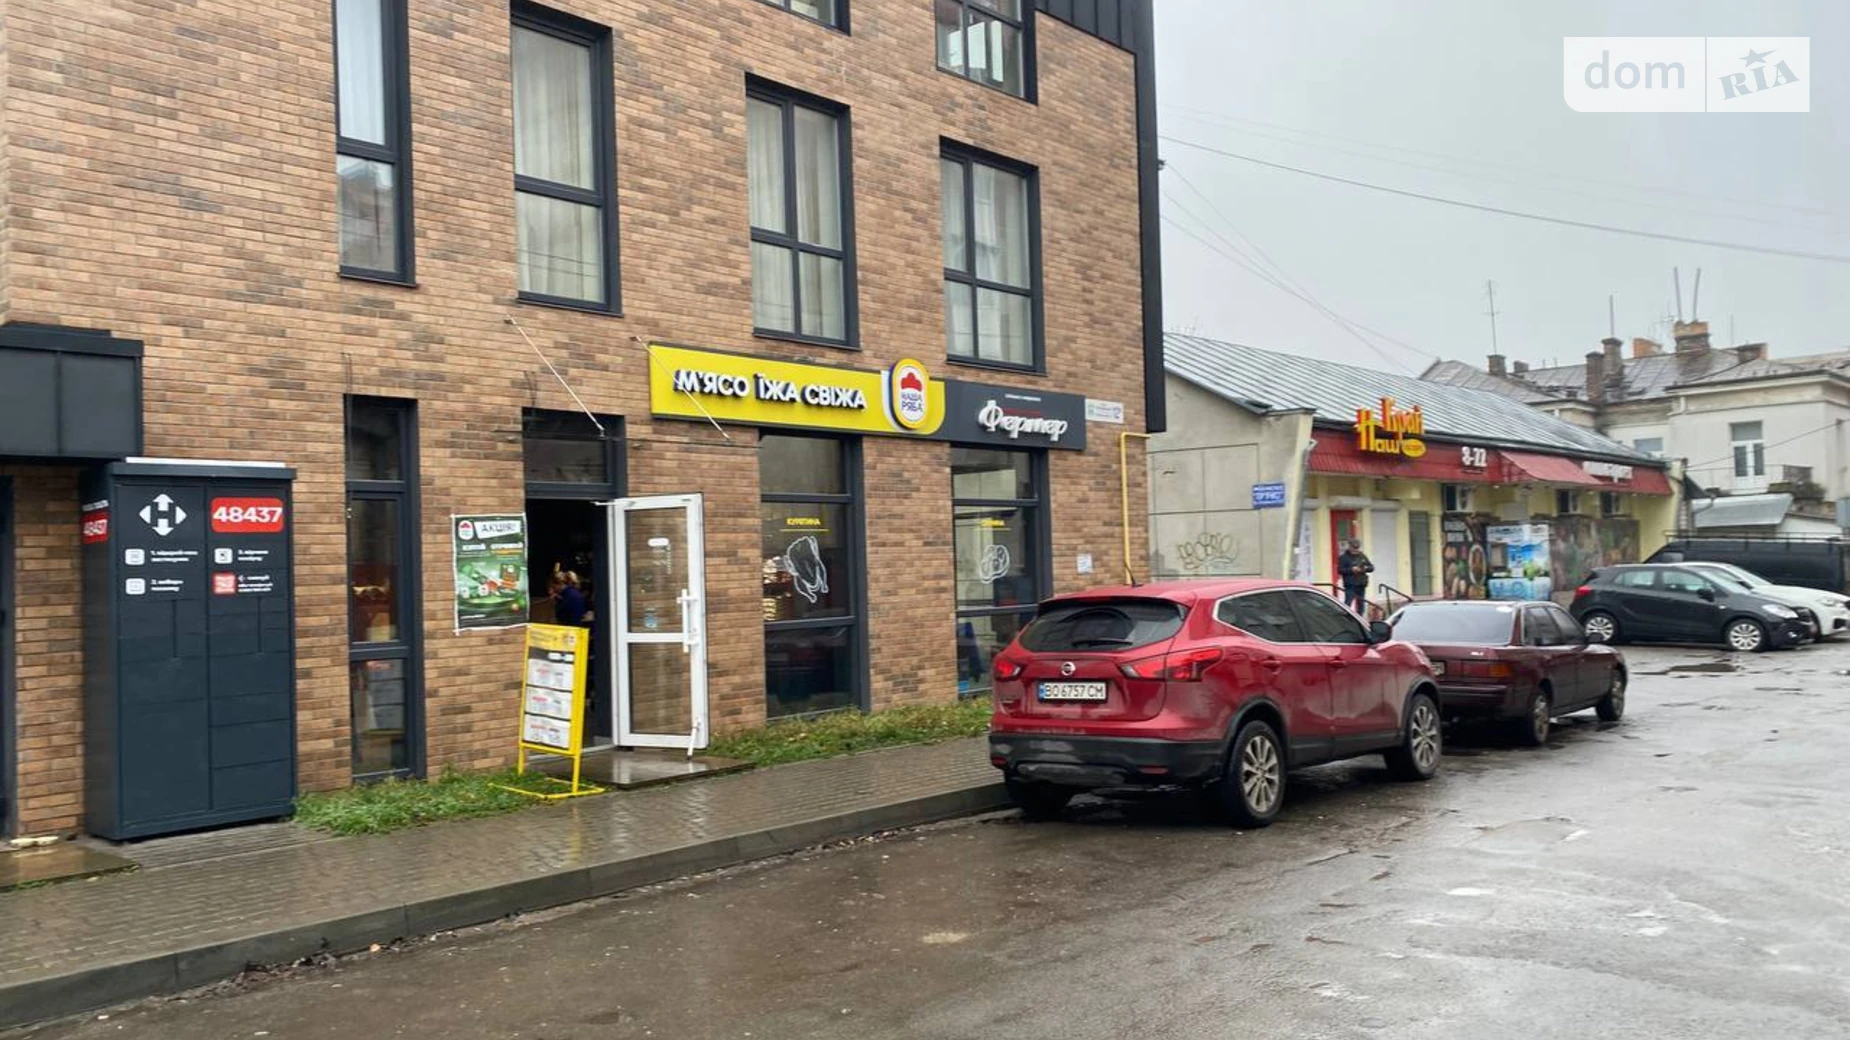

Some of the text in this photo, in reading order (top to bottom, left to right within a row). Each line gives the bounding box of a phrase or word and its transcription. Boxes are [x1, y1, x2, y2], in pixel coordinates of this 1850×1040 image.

[674, 368, 868, 412] М'ЯСО ЇЖА СВІЖА
[213, 506, 282, 523] 48437
[1060, 684, 1086, 697] 6757
